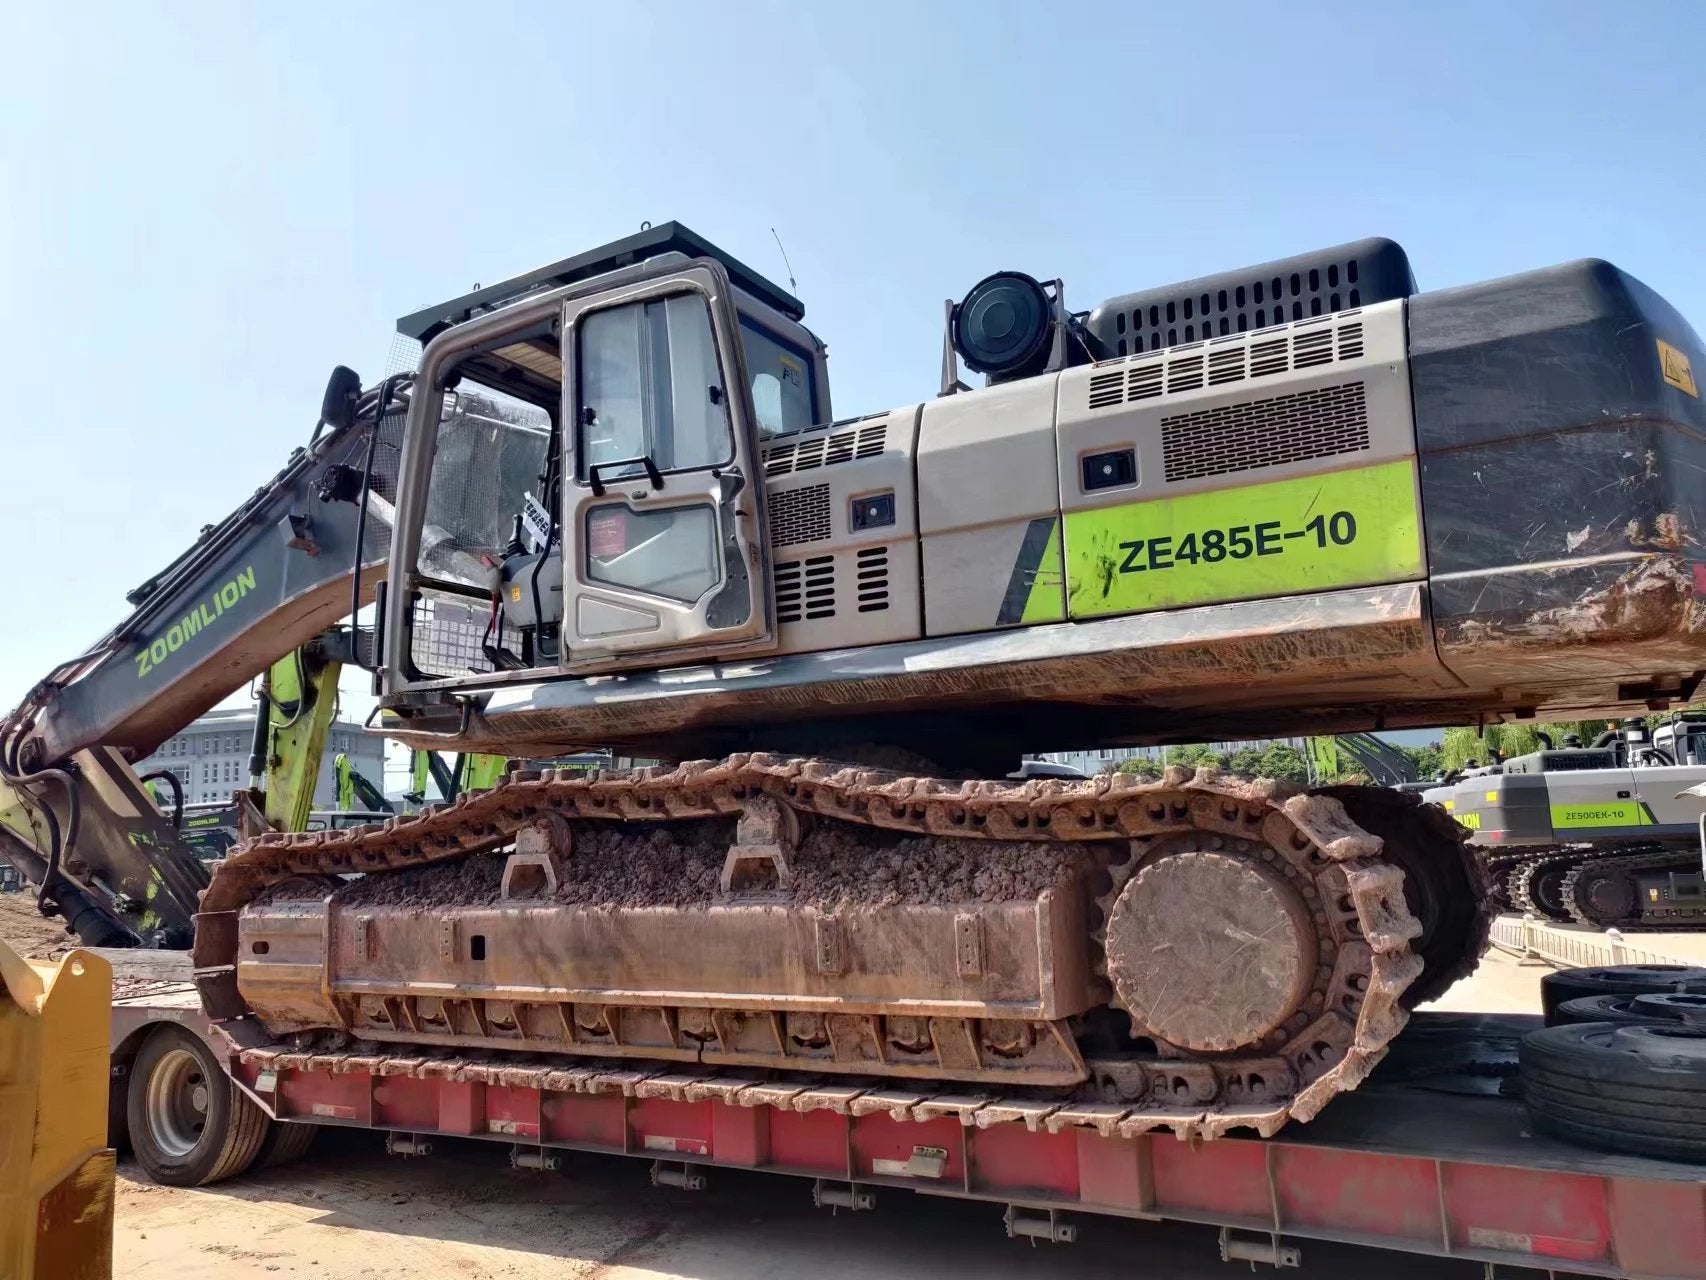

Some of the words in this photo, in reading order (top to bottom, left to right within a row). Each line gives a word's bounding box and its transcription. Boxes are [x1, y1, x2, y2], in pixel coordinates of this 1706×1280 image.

[1118, 510, 1357, 574] ZE485E-10
[135, 566, 256, 678] ZOOMLION
[1565, 810, 1624, 820] ZE500EK-10
